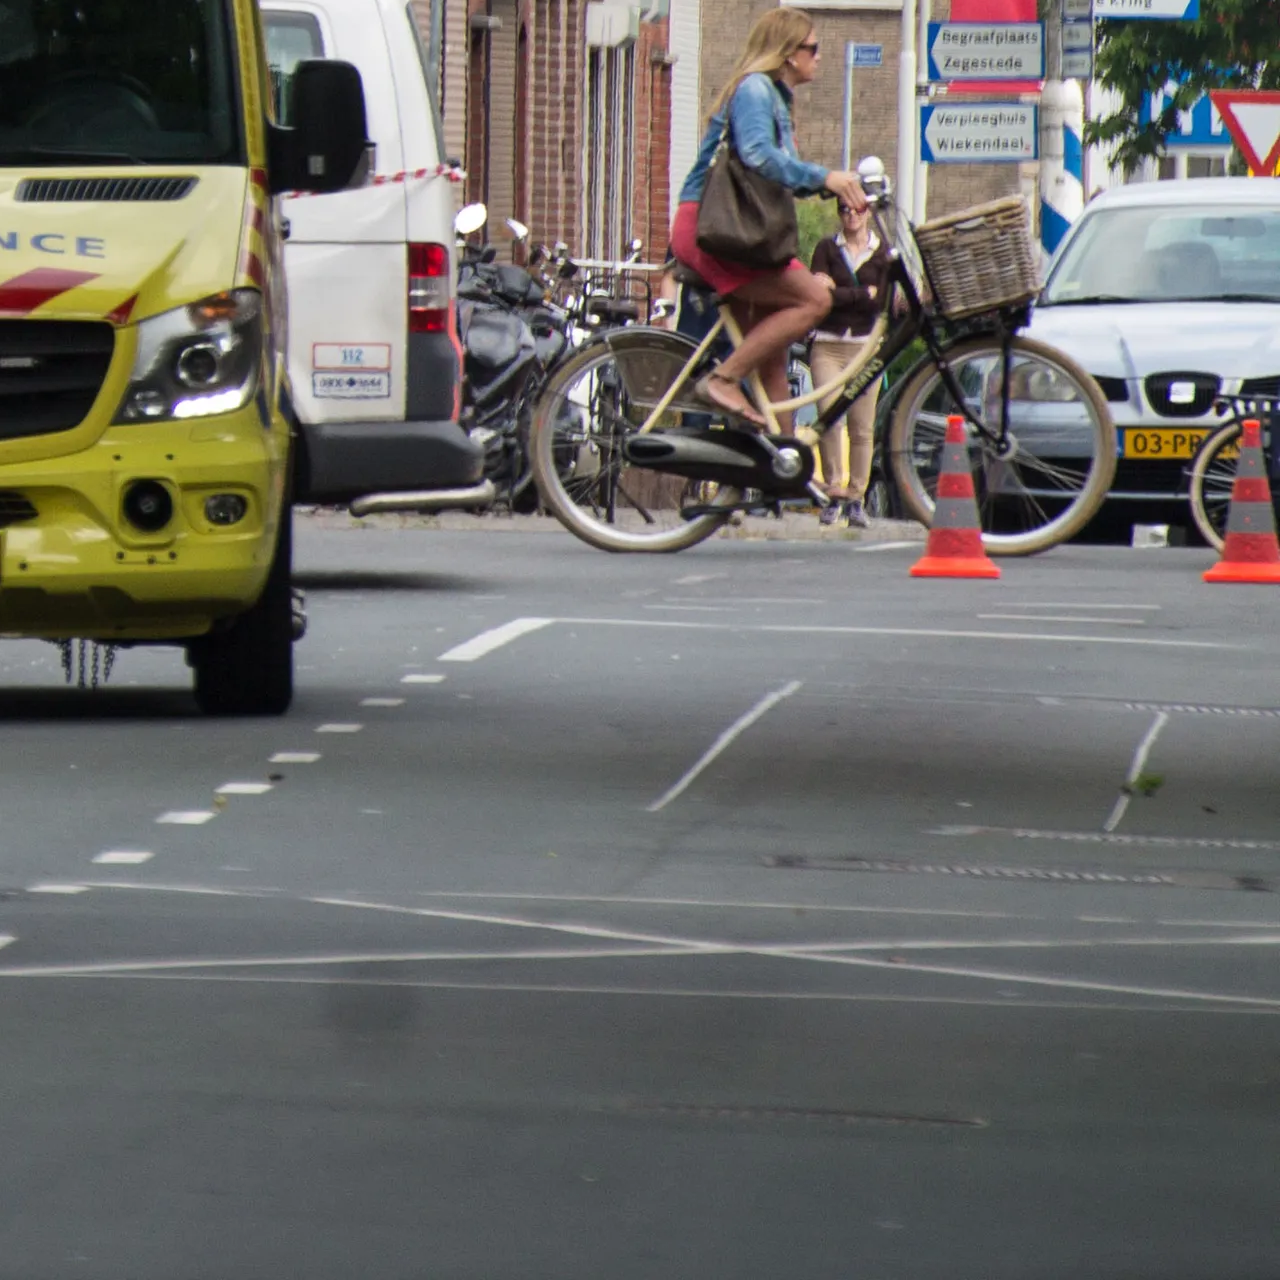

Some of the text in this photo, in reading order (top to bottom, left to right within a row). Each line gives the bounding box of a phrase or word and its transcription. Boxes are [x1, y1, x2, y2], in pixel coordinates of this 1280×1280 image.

[942, 29, 1038, 46] Begraafplaats
[943, 56, 1022, 71] Zegestede
[937, 111, 1027, 127] Verpleeghuis
[342, 348, 363, 361] 112
